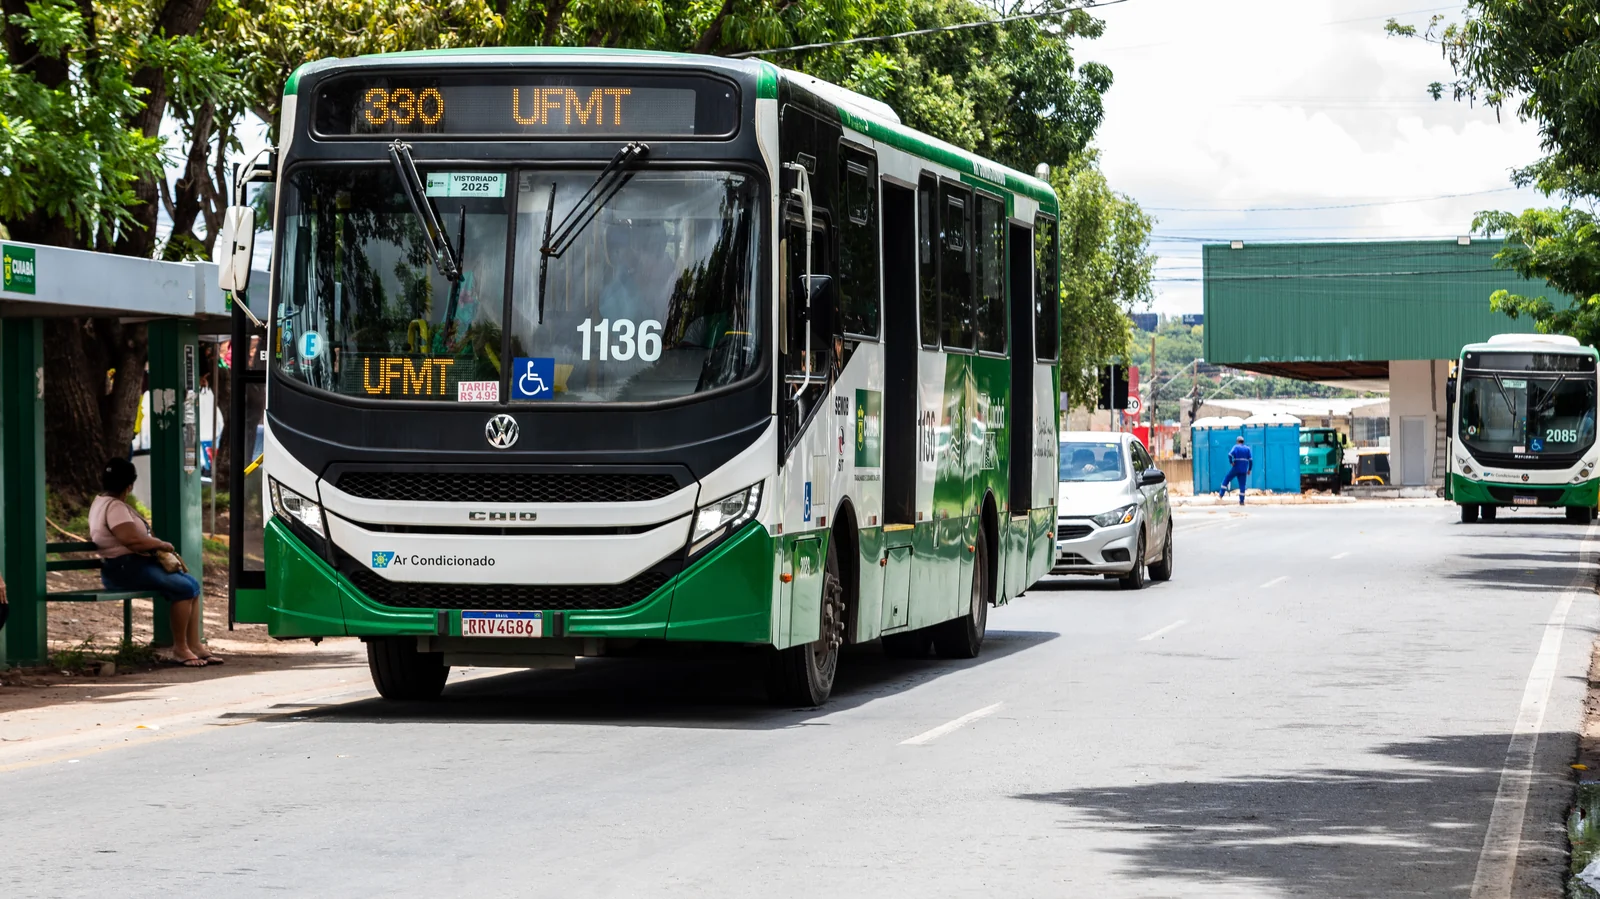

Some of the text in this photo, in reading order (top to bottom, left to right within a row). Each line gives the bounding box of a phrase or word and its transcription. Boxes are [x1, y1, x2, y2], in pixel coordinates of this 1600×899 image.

[365, 88, 632, 125] 330 UFMT
[461, 182, 490, 192] 2025
[305, 334, 317, 356] E
[576, 318, 663, 362] 1136
[364, 357, 454, 395] UFMT
[460, 382, 498, 391] TARIFA
[460, 391, 498, 401] R$ 4.95
[918, 410, 936, 462] 1136
[1546, 429, 1577, 442] 2085
[468, 511, 537, 522] CAIO
[394, 555, 496, 567] Ar Condicionado
[468, 619, 534, 635] RRV4G86
